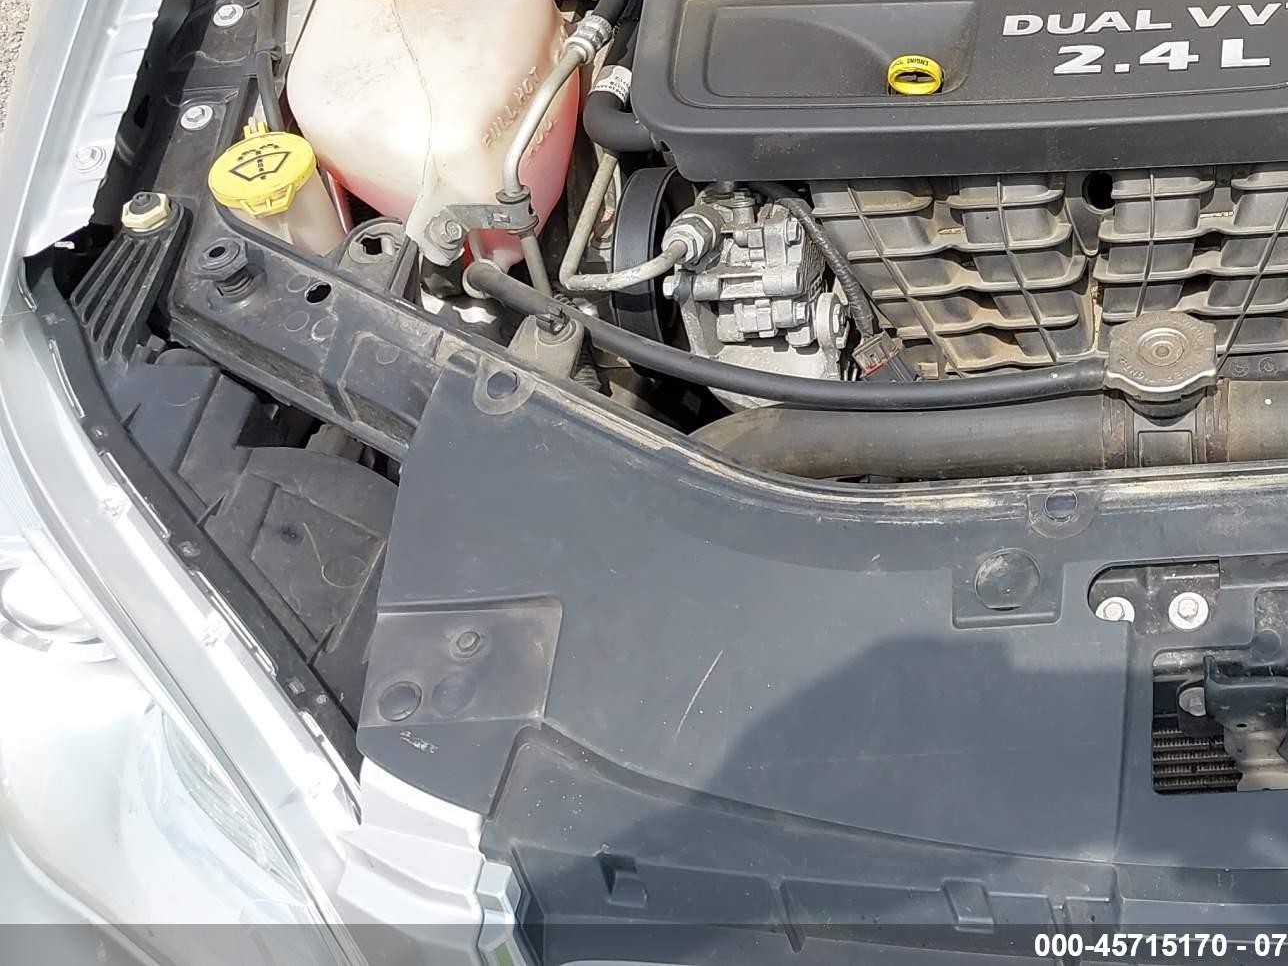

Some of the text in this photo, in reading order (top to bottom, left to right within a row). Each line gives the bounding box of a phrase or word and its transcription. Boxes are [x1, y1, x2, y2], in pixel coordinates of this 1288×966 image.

[1002, 8, 1173, 37] DUAL
[1053, 38, 1271, 76] 2.4 L
